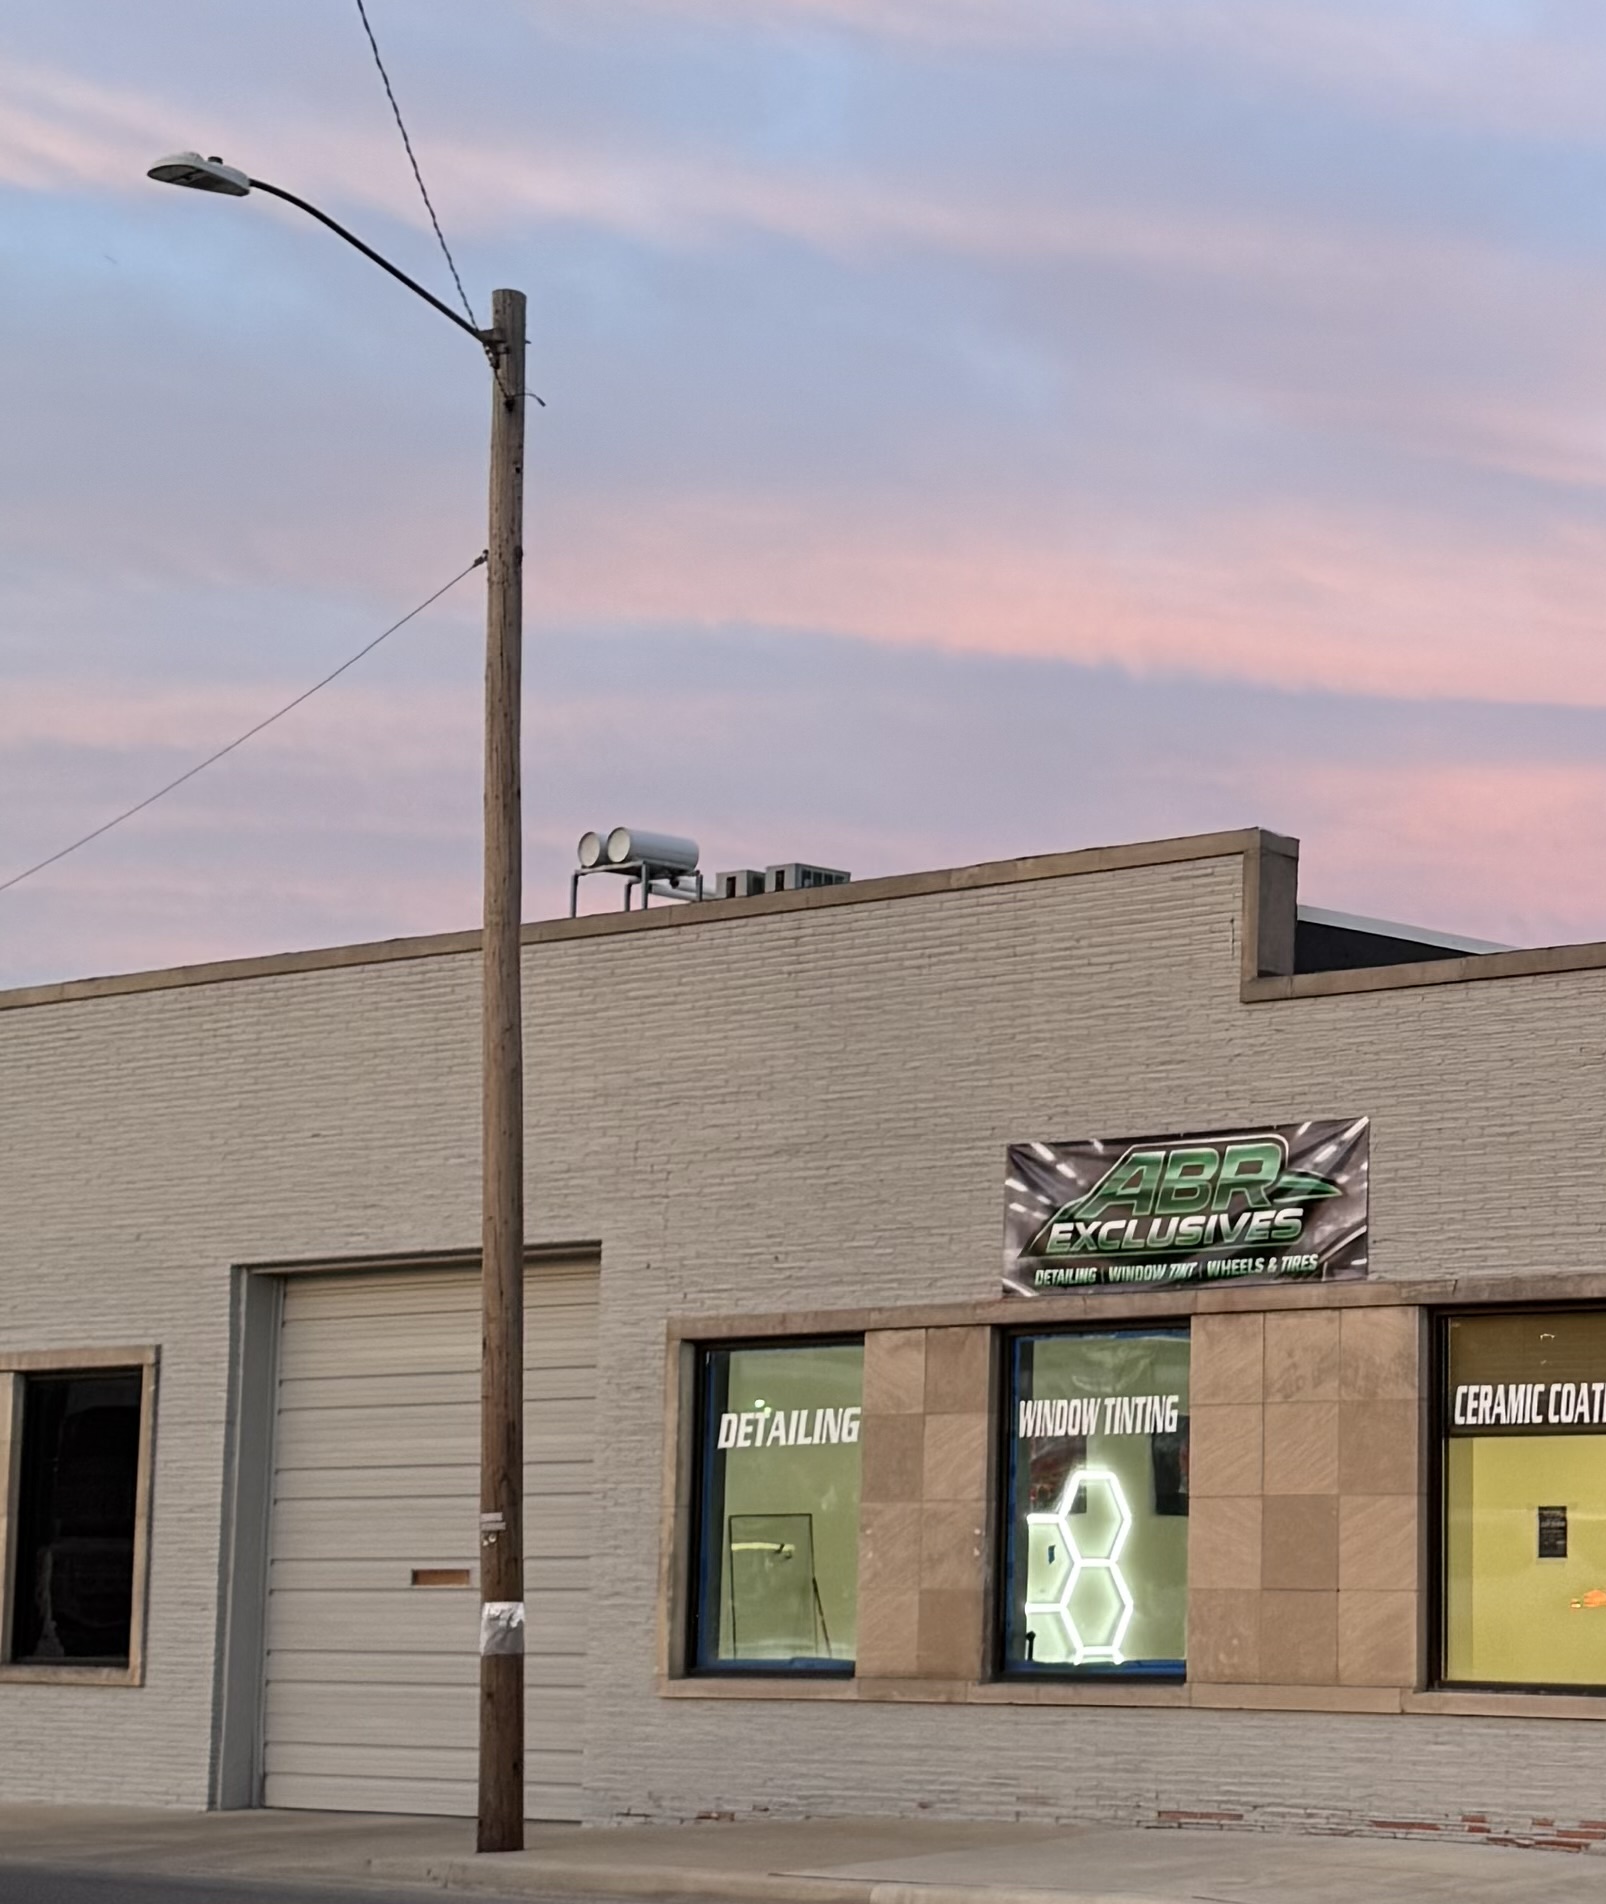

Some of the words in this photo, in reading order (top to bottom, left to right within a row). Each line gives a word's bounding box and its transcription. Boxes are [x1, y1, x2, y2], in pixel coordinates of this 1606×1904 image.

[1074, 1142, 1284, 1218] ABR
[1046, 1207, 1304, 1254] EXCLUSIVES
[1034, 1266, 1098, 1286] DETAILING
[1108, 1263, 1167, 1282] WINDOW
[1168, 1261, 1198, 1279] TINT
[1206, 1257, 1265, 1277] WHEELS
[1267, 1256, 1278, 1273] &
[1281, 1253, 1319, 1272] TIRES
[1019, 1398, 1101, 1438] WINDOW
[1103, 1395, 1179, 1435] TINTING
[1454, 1383, 1546, 1425] CERAMIC
[717, 1406, 861, 1449] DETAILING
